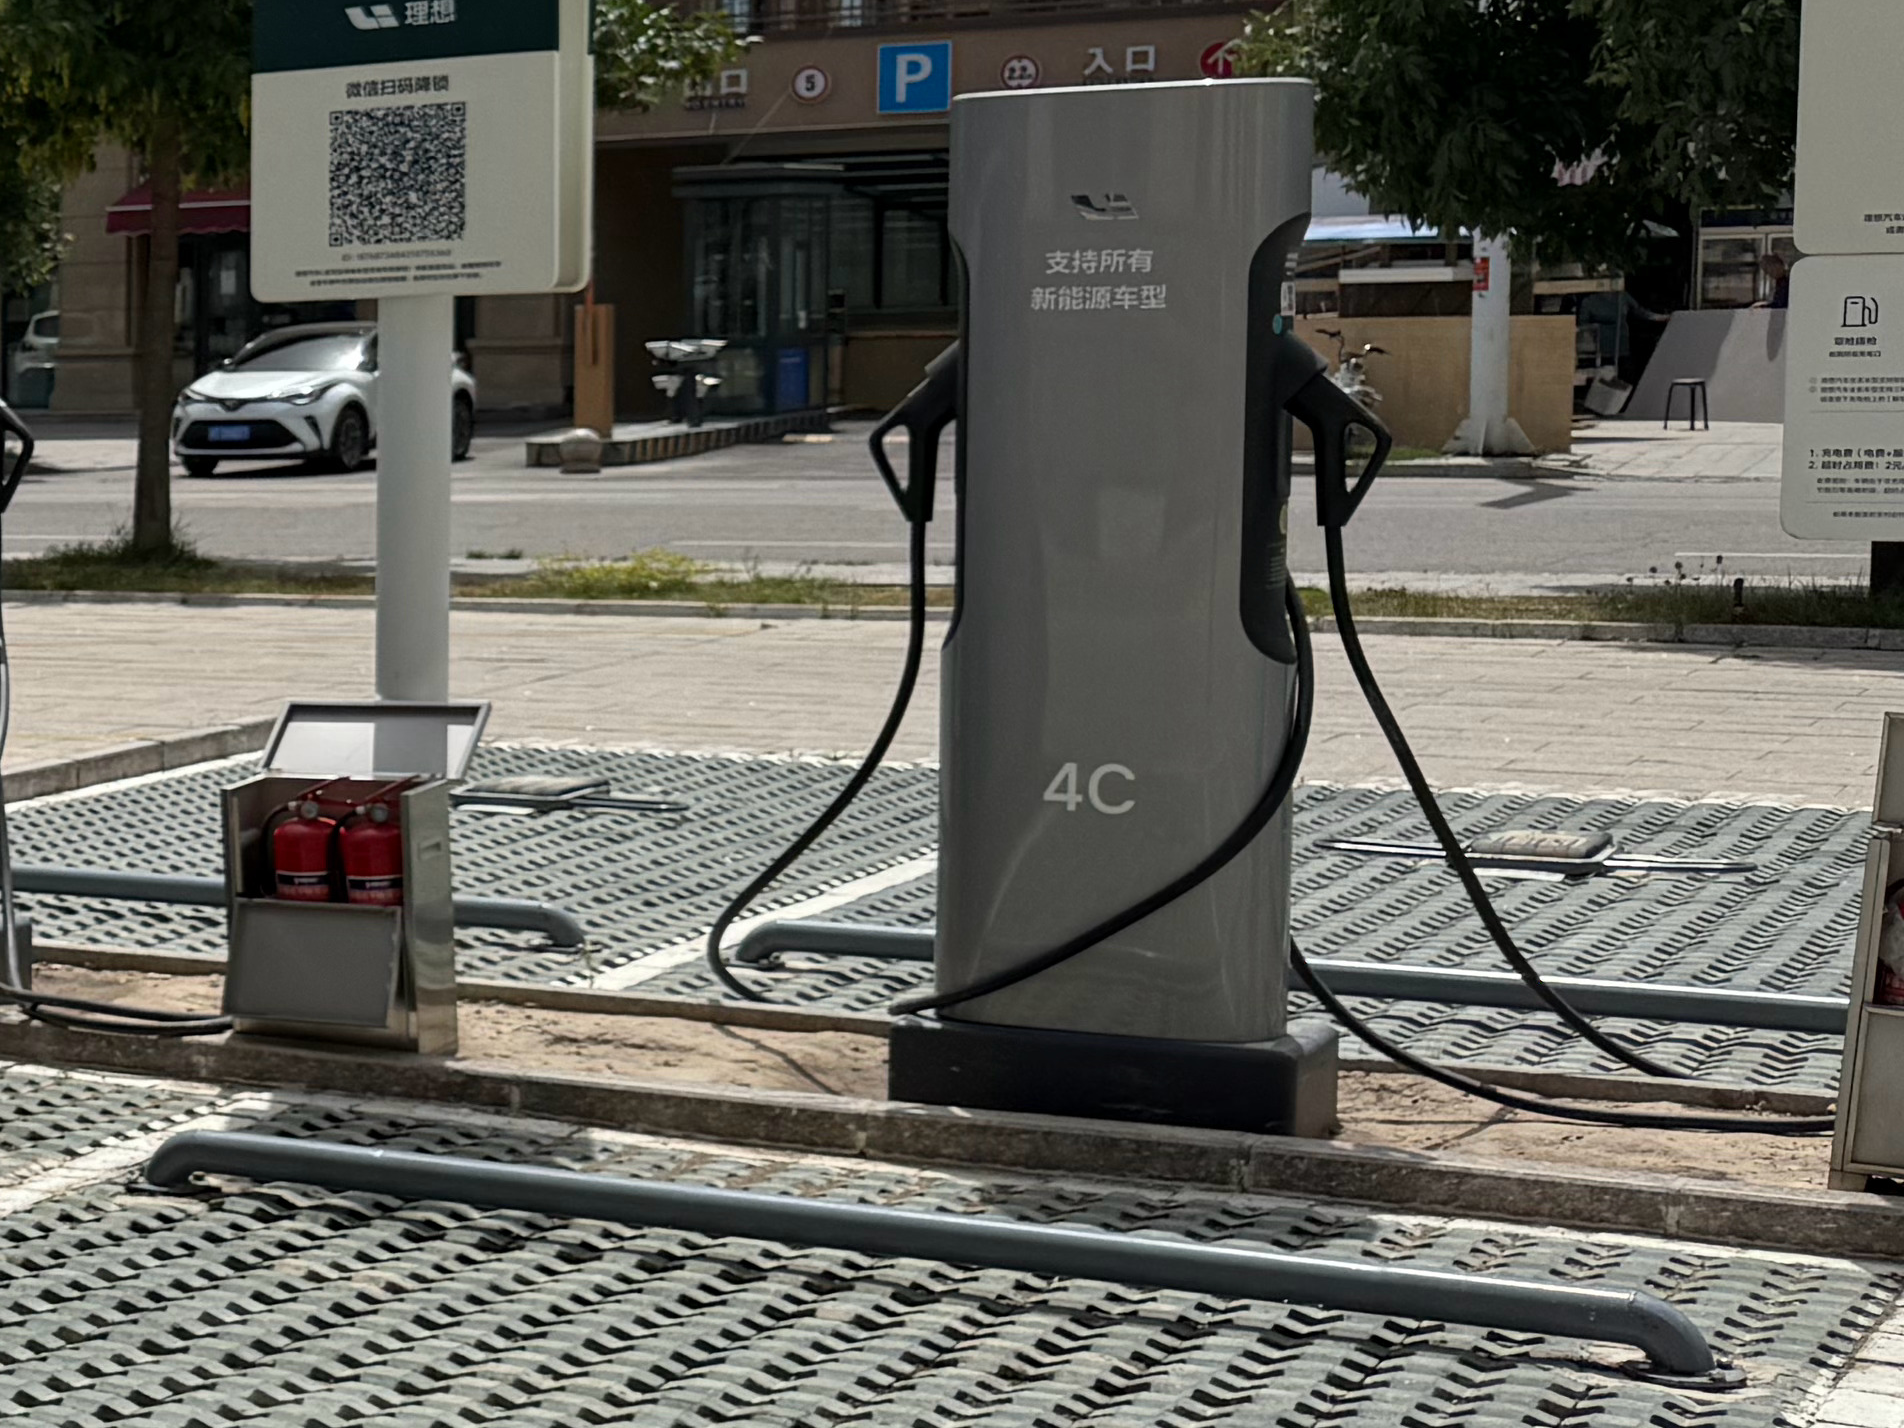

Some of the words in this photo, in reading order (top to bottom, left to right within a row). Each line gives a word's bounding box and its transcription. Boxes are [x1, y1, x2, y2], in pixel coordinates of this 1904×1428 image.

[1084, 45, 1156, 75] 入口
[345, 75, 450, 99] 微信扫码降锁
[804, 74, 816, 93] 5
[895, 53, 933, 104] P
[1045, 249, 1155, 275] 支持所有
[1030, 284, 1168, 311] 新能源车型
[1042, 762, 1138, 815] 4C
